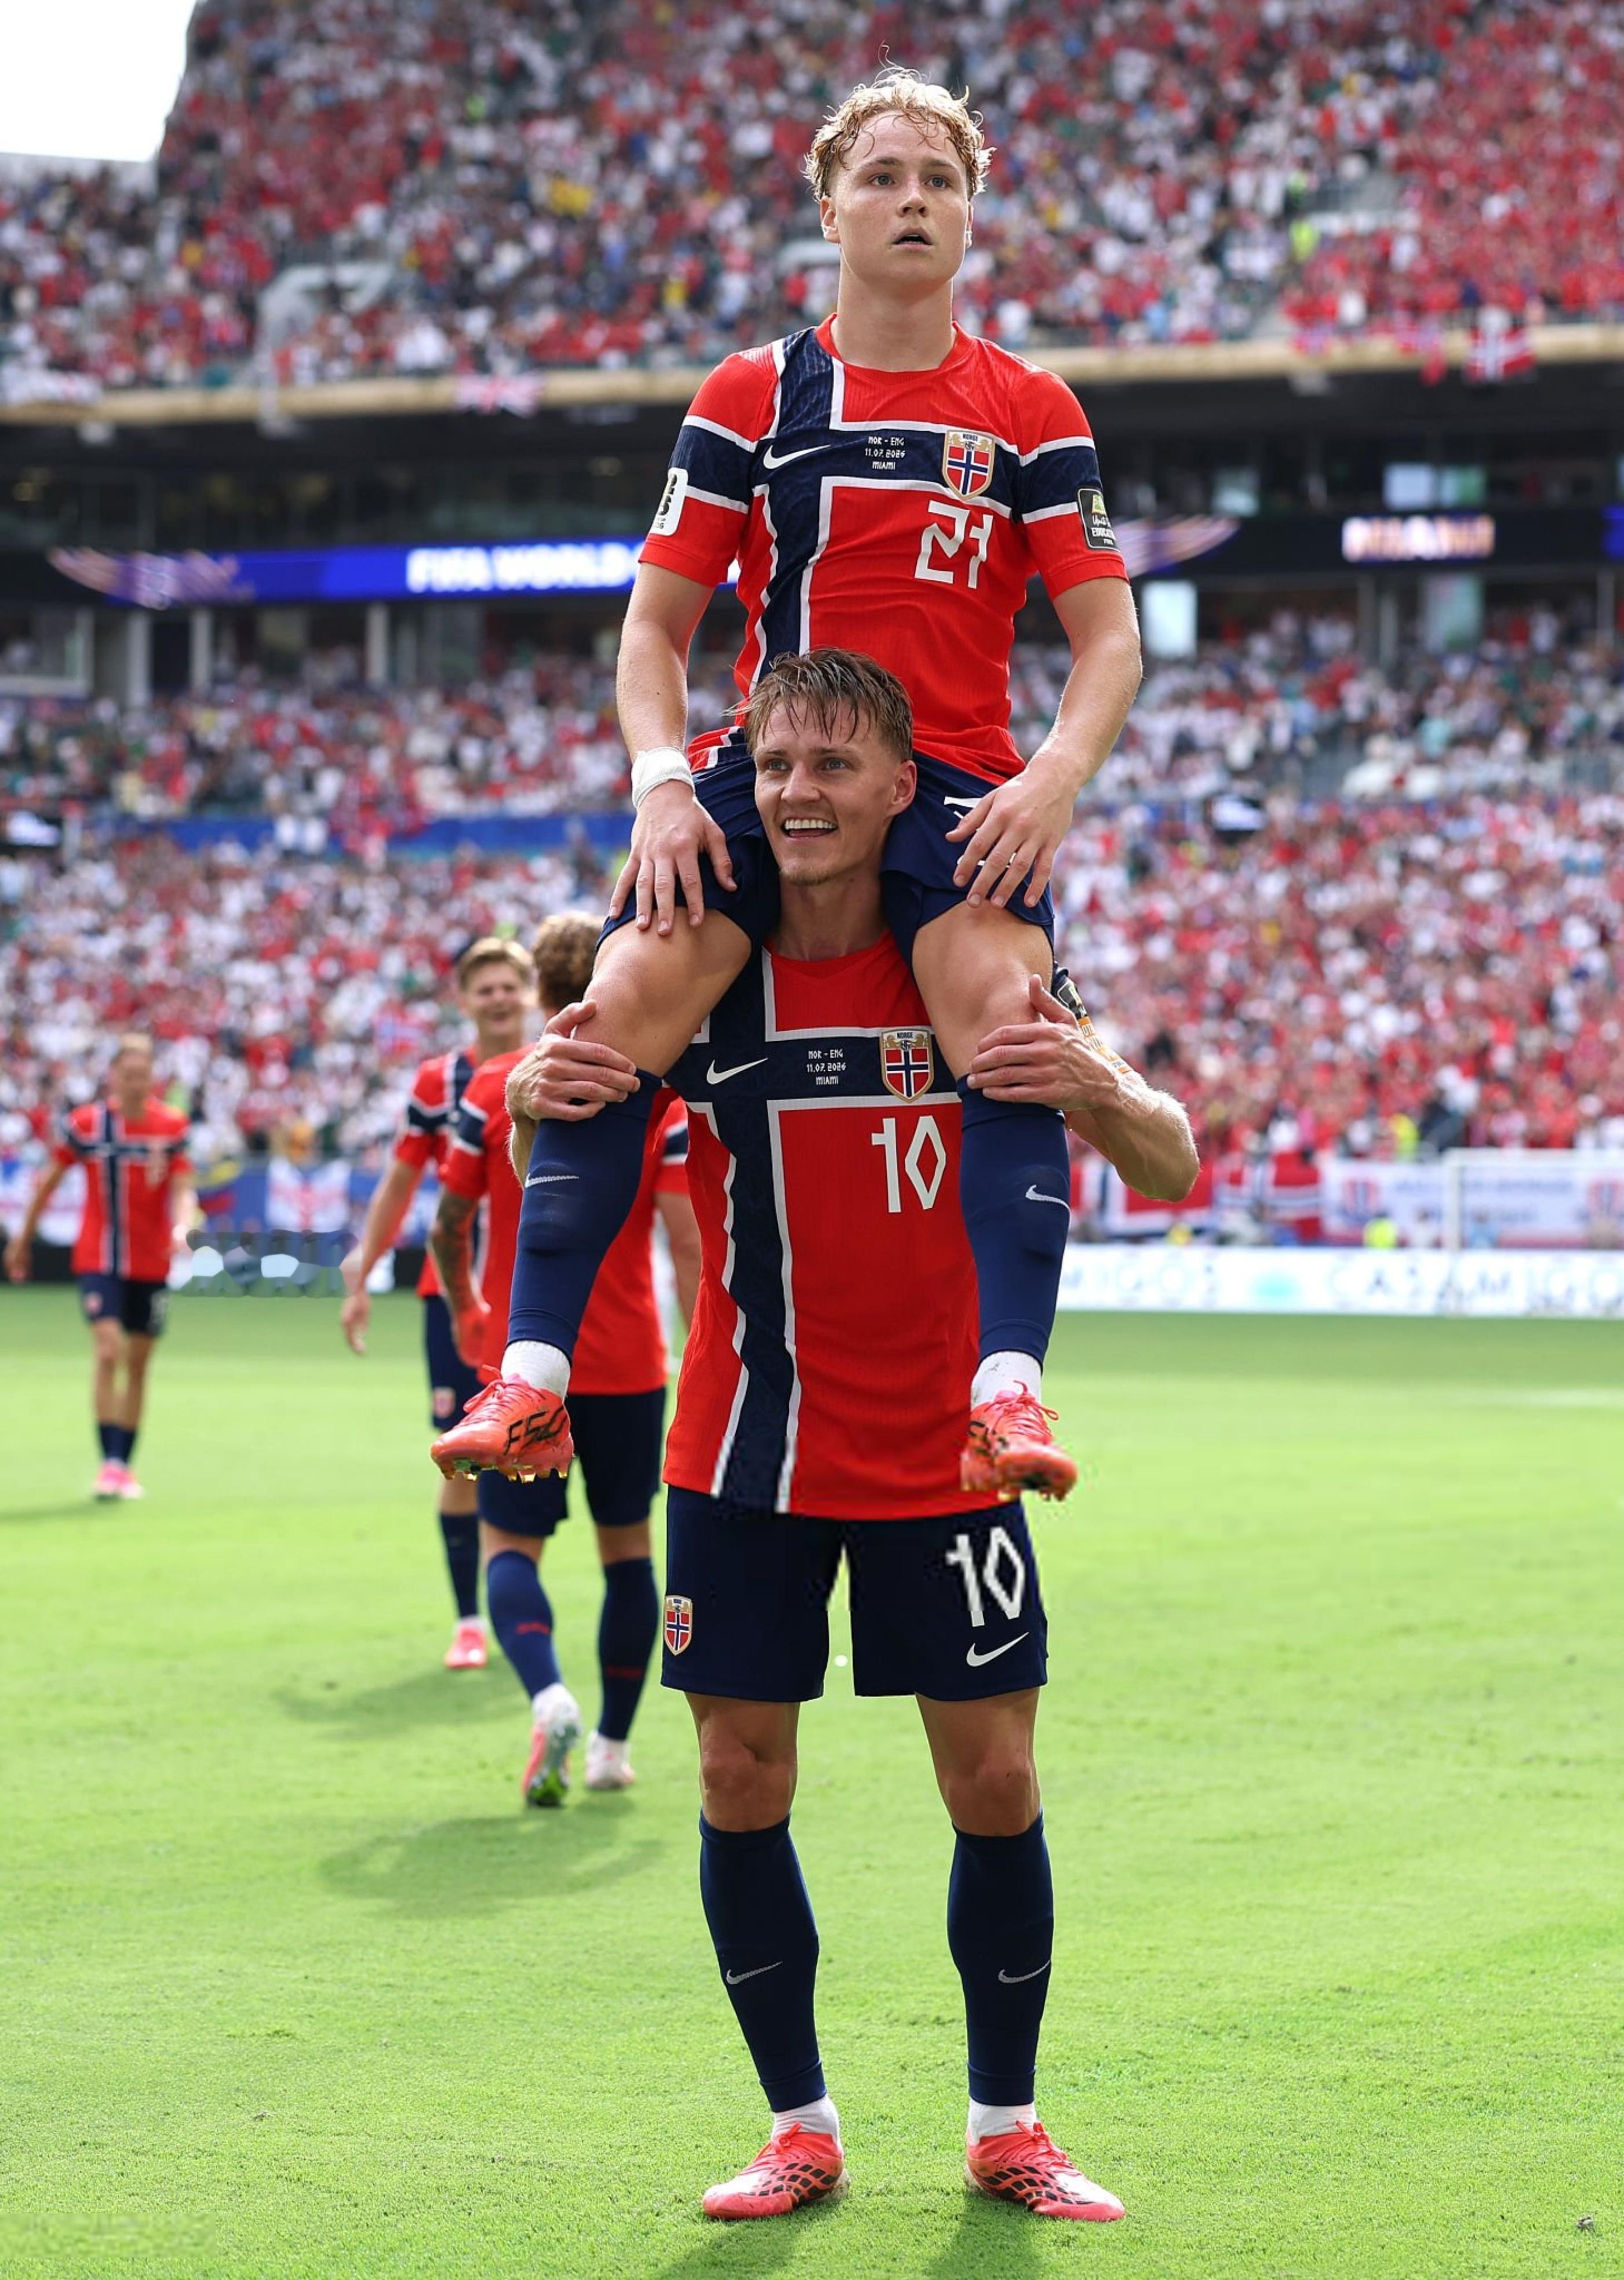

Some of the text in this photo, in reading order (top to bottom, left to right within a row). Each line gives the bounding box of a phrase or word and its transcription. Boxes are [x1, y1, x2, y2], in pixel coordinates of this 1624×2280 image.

[872, 461, 895, 470] MIAMI
[915, 500, 993, 589] 21
[815, 1075, 839, 1085] MIAMI
[871, 1115, 946, 1213] 10
[945, 1527, 1025, 1627] 10
